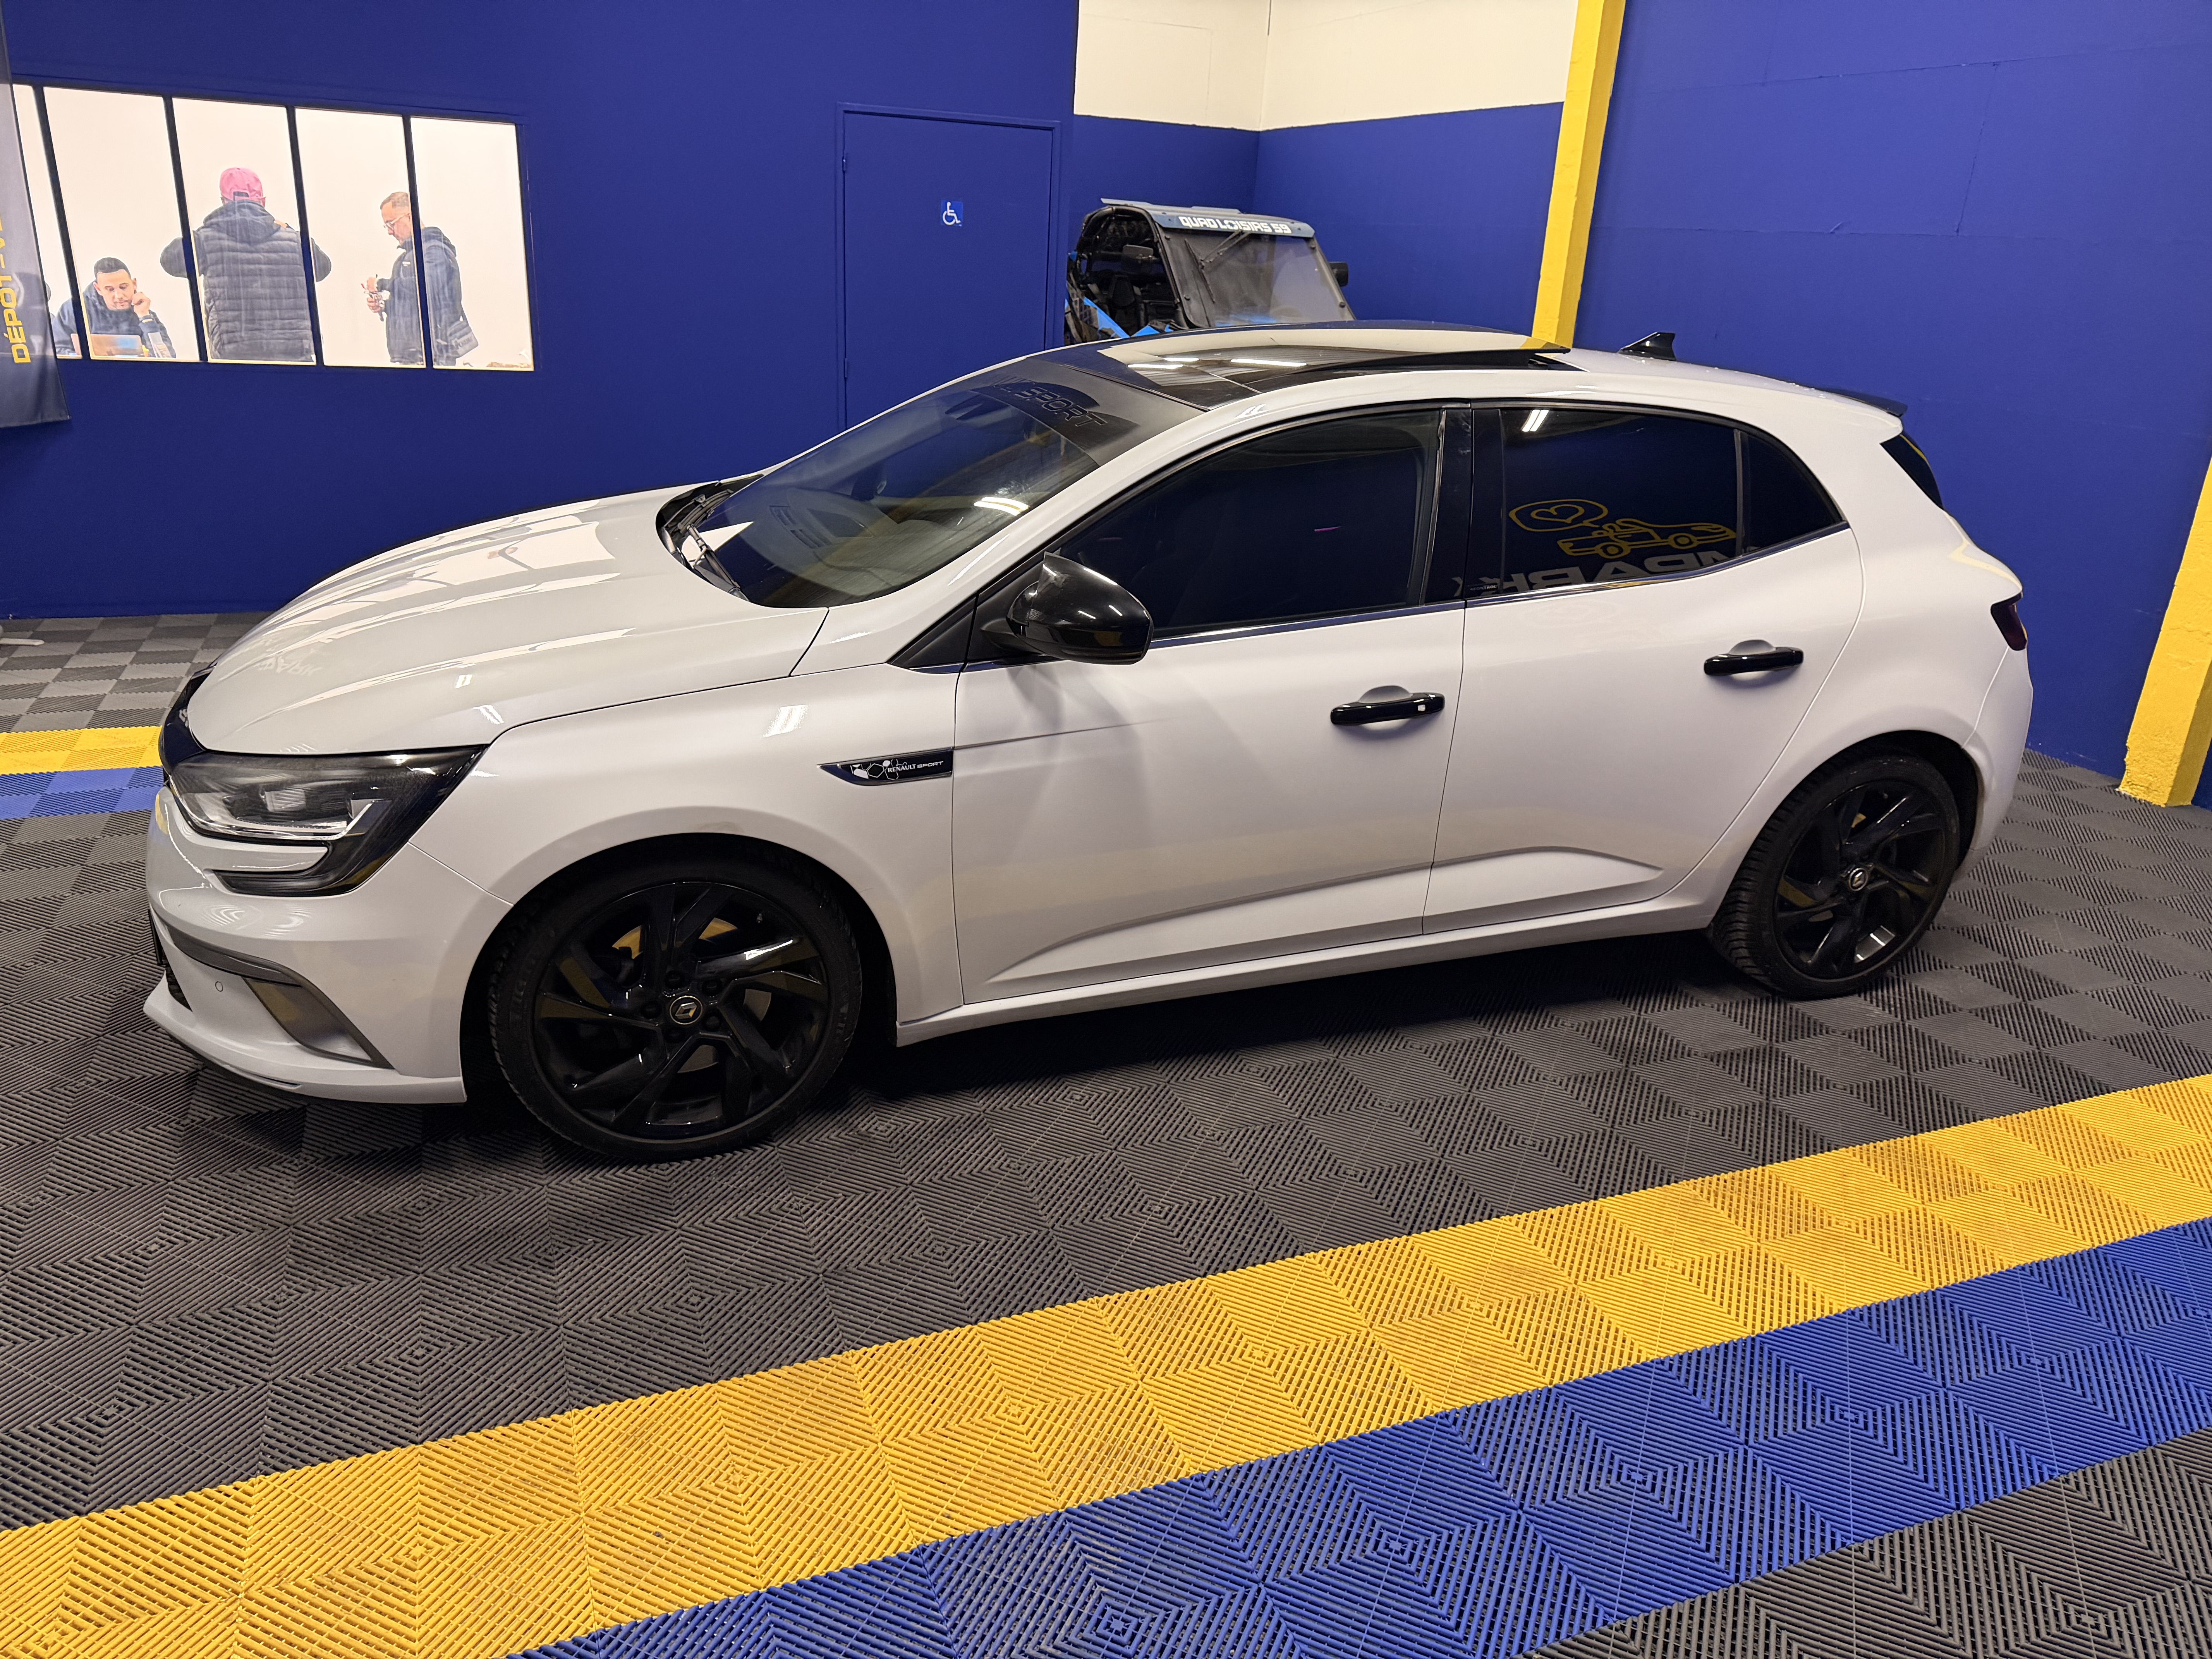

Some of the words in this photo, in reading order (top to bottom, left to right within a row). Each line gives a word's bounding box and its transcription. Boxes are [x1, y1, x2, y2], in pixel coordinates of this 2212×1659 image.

[1178, 216, 1218, 228] QUAD
[1216, 219, 1273, 232] LOISIRS
[1270, 224, 1292, 234] 59
[1014, 386, 1109, 427] SPORT
[887, 764, 917, 773] RENAULT
